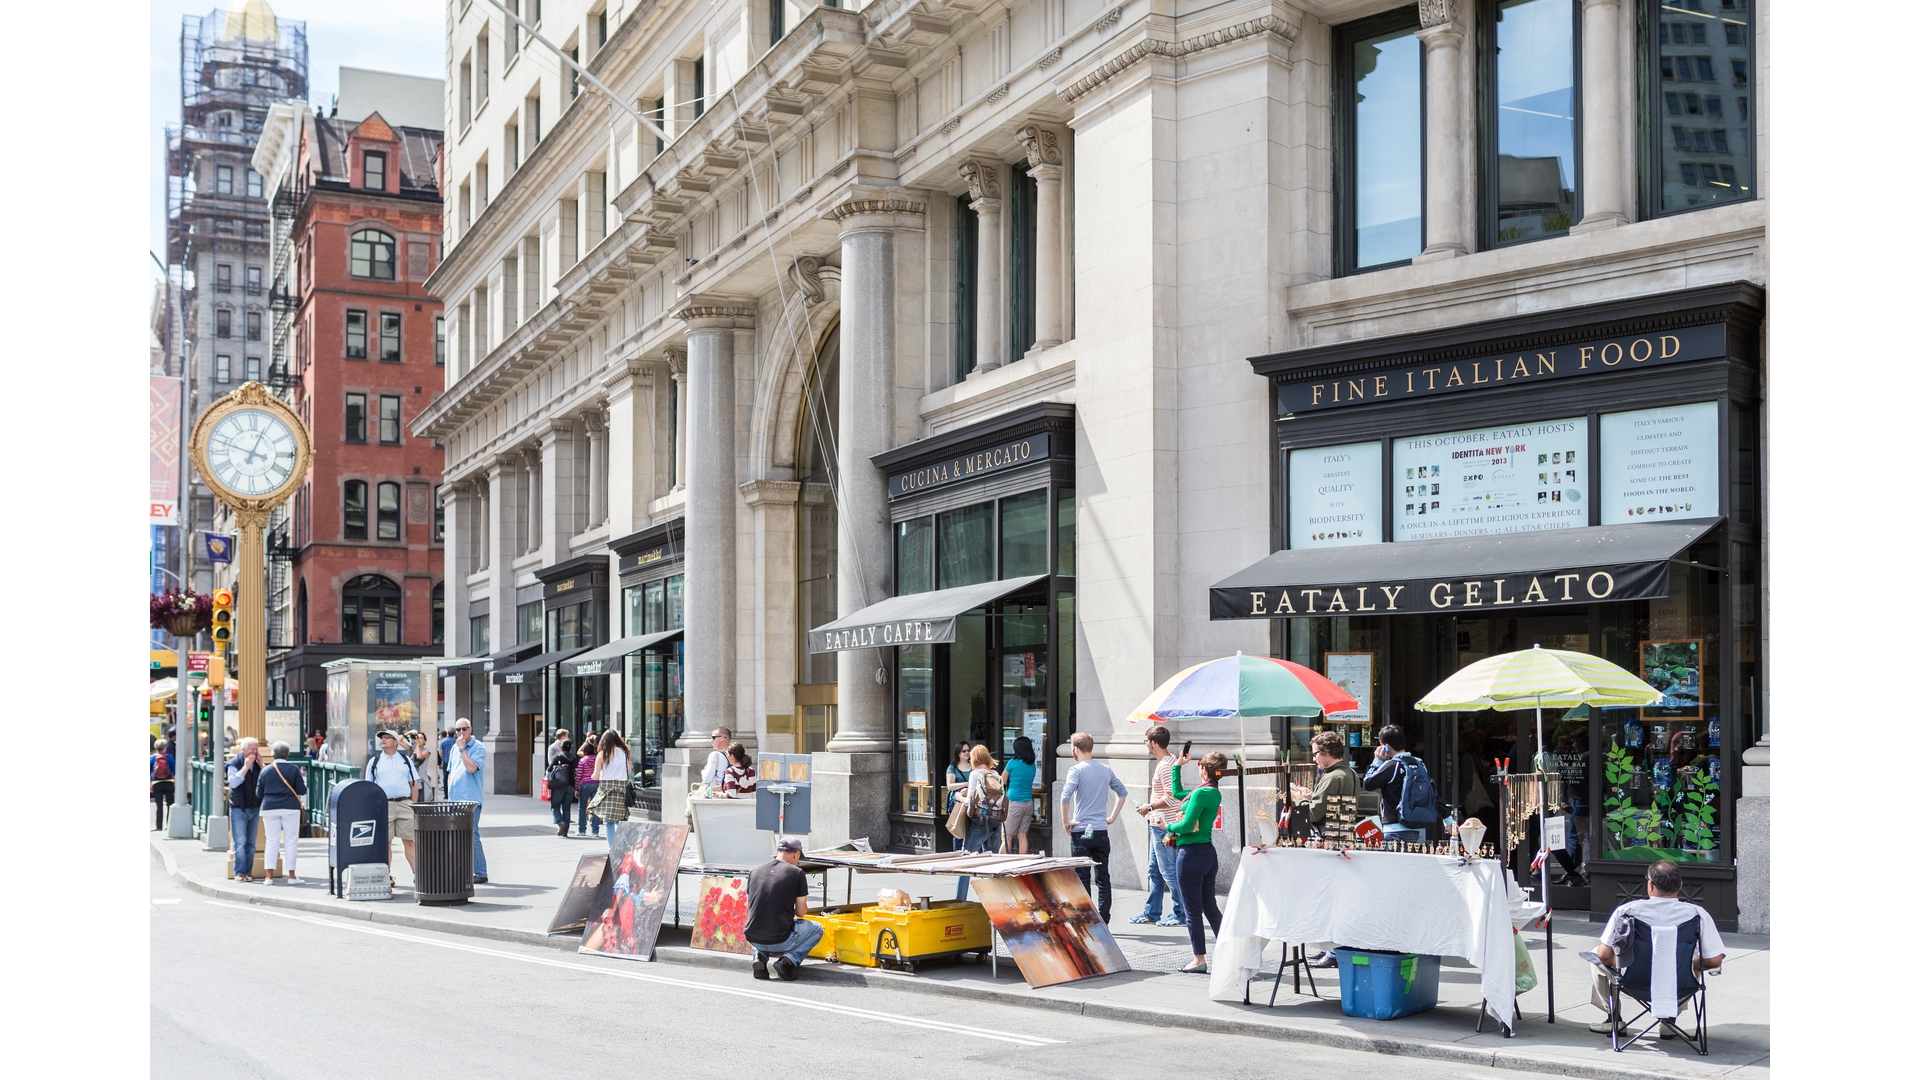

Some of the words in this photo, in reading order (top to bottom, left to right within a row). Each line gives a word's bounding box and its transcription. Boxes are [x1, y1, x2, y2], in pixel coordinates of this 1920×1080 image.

[1311, 376, 1389, 406] FINE
[1405, 350, 1557, 393] ITALIAN
[1579, 334, 1682, 370] FOOD
[1657, 416, 1685, 424] VARIOUS
[1407, 439, 1432, 450] THIS
[1434, 433, 1489, 446] OCTOBER,
[1493, 427, 1535, 440] EATALY
[1537, 422, 1576, 435] HOSTS
[1636, 433, 1668, 441] CLIMATES
[1485, 446, 1503, 456] NEW
[1630, 447, 1660, 456] DISTINCT
[1661, 445, 1689, 453] TERRAIN
[901, 464, 949, 491] CUCINA
[953, 460, 961, 477] &
[965, 441, 1031, 475] MERCATO
[1491, 457, 1507, 466] 2013
[1627, 463, 1657, 471] COMBINE
[1667, 459, 1692, 467] CREATE
[235, 462, 271, 476] BUILDING
[1323, 471, 1351, 479] GREATEST
[1463, 473, 1484, 482] EXPO
[1318, 483, 1354, 496] QUALITY
[1623, 490, 1646, 498] FOODS
[1309, 513, 1366, 525] BIODIVERSITY
[1406, 516, 1486, 530] ONCE-IN-A-LIFETIME
[1486, 512, 1530, 523] DELICIOUS
[1531, 508, 1583, 520] EXPERIENCE
[1410, 530, 1448, 540] SEMINARS
[1454, 527, 1489, 537] DINNERS
[1503, 525, 1521, 533] ALL
[1521, 522, 1543, 531] STAR
[1543, 520, 1571, 529] CHEFS
[637, 548, 663, 565] marimekko
[1250, 585, 1404, 615] EATALY
[1429, 571, 1614, 609] GELATO
[1658, 608, 1679, 616] EATALY
[825, 626, 877, 650] EATALY
[577, 661, 602, 675] marimekko
[505, 673, 524, 684] marimekko
[425, 673, 433, 713] Newsstand
[1551, 834, 1561, 845] $10
